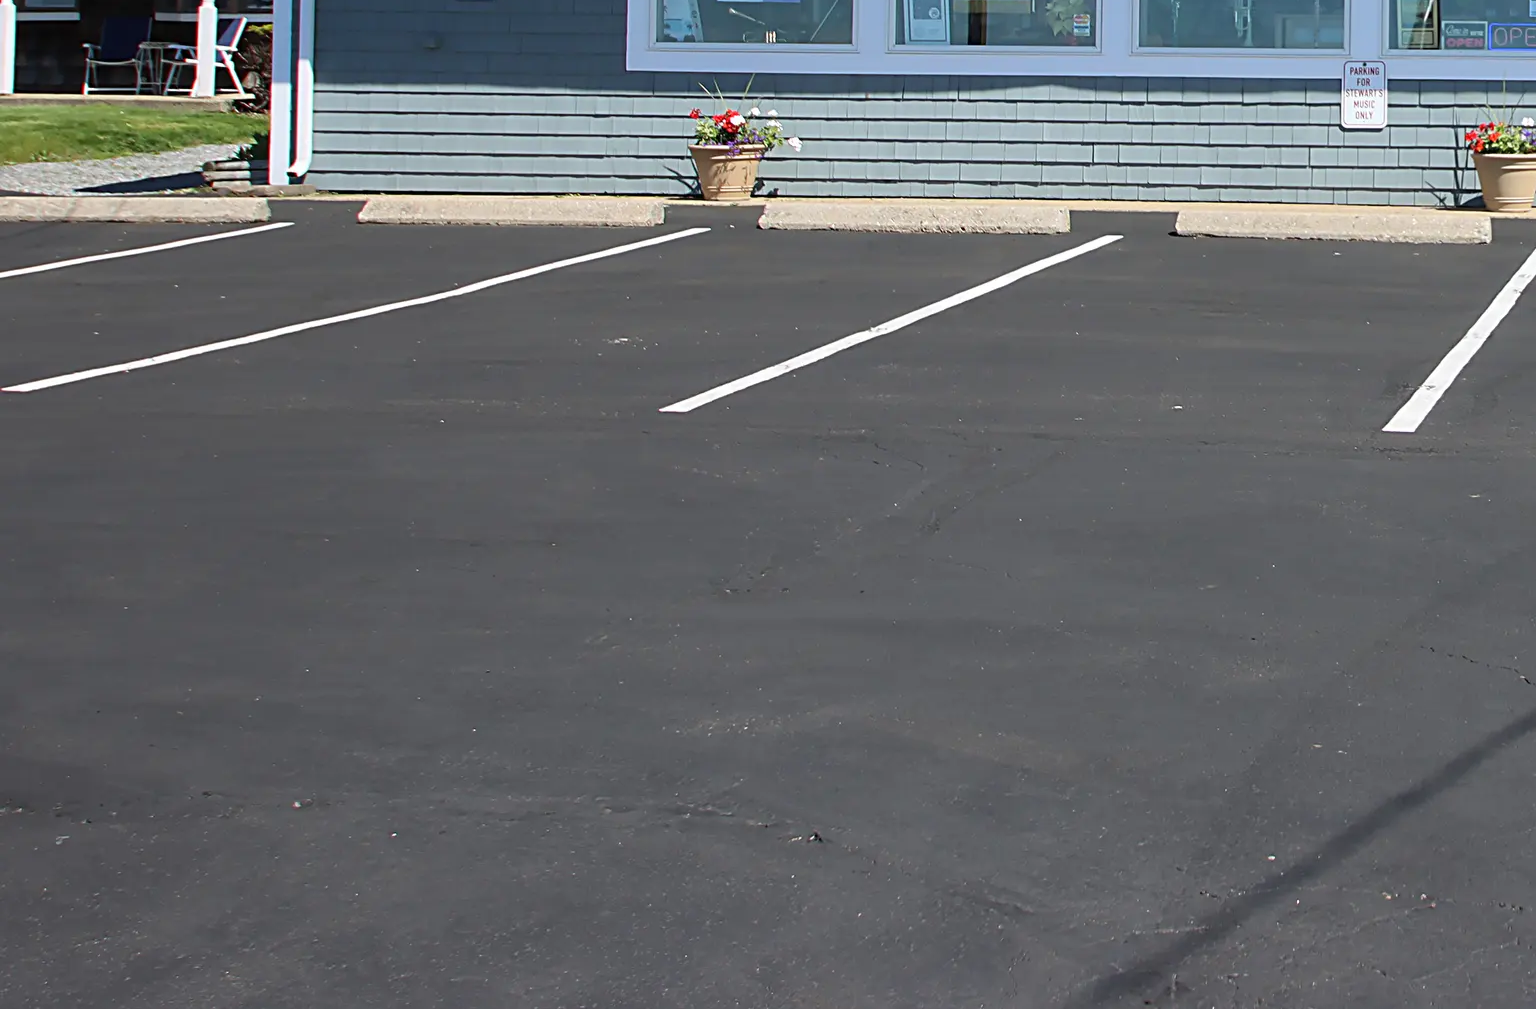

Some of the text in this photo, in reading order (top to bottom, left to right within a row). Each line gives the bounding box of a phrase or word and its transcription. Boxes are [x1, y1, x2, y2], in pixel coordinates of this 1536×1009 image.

[1446, 38, 1484, 47] OPEN
[1350, 67, 1380, 75] PARKING
[1357, 78, 1370, 86] FOR
[1354, 100, 1375, 108] MUSIC
[1356, 111, 1373, 120] ONLY
